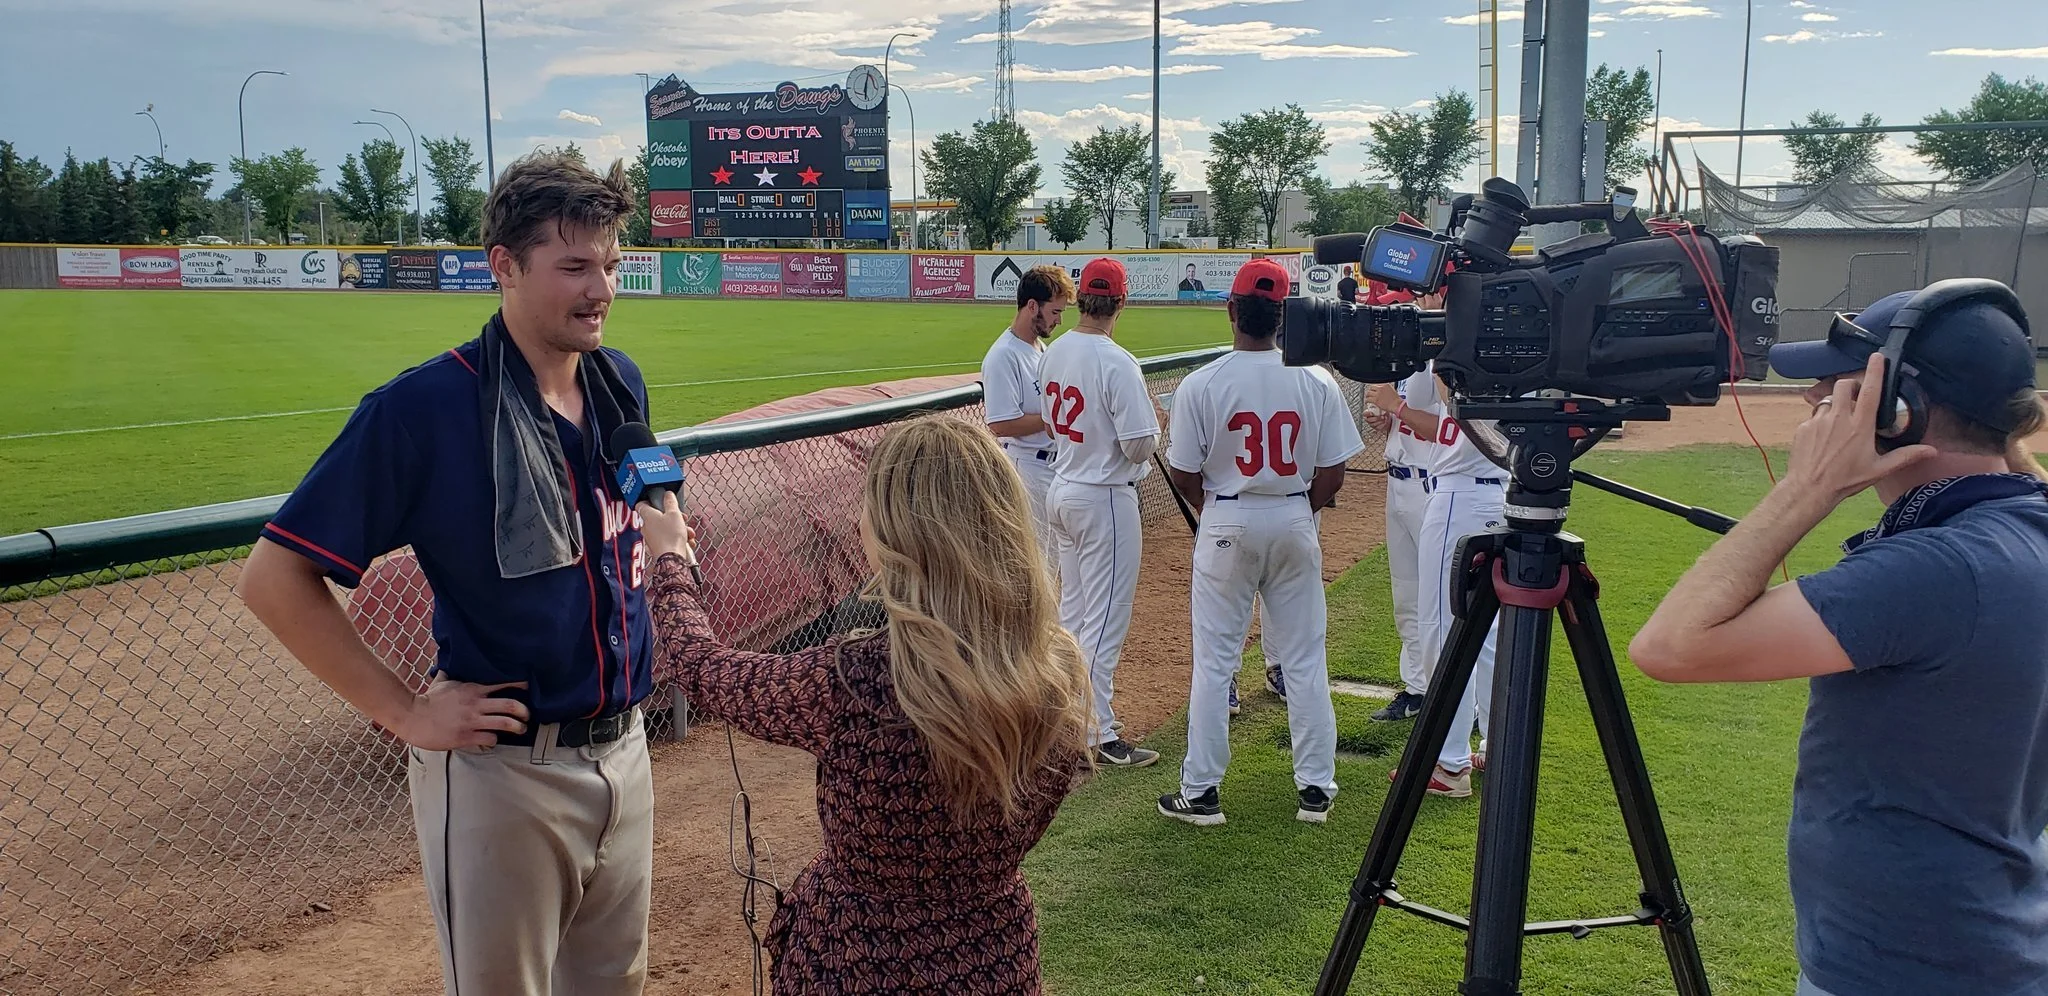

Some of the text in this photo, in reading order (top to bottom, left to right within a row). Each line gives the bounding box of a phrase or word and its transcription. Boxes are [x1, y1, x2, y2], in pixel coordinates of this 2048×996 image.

[650, 89, 687, 109] Seaman
[693, 84, 842, 115] Home of the Dawgs
[651, 100, 692, 119] Stadium
[854, 127, 886, 135] PHOENIX
[650, 141, 688, 153] Okotoks
[651, 154, 688, 169] Sobeys
[848, 158, 881, 167] AM 1140
[719, 195, 737, 204] BALL
[750, 195, 775, 204] STRIKE
[791, 195, 806, 204] OUT
[851, 209, 882, 220] DASANI
[704, 218, 721, 227] EAST
[703, 227, 721, 236] WEST
[180, 252, 196, 262] GOOD
[212, 252, 233, 263] PARTY
[1387, 248, 1410, 260] Global
[129, 260, 173, 268] BOW MARK
[444, 260, 458, 270] NAPA
[814, 256, 831, 264] Best
[862, 258, 903, 267] BUDGET
[1202, 259, 1216, 267] Joel
[1391, 257, 1408, 265] NEWS
[618, 262, 652, 274] OLUMBO'S
[806, 264, 839, 273] Western
[862, 267, 897, 277] BLINDS
[922, 266, 961, 276] AGENCIES
[181, 276, 204, 284] Calgary
[210, 276, 234, 284] Okotoks
[735, 272, 780, 280] Merkley Group
[812, 272, 834, 281] PLUS
[1126, 274, 1169, 285] KOTOKS
[1310, 271, 1330, 280] FORD
[242, 276, 282, 286] 938-4455
[301, 277, 327, 286] CALFRAC
[996, 279, 1019, 287] GIANT
[724, 284, 778, 294] (403) 298-4014
[786, 287, 810, 295] Okotoks
[826, 287, 844, 295] Suites
[914, 281, 972, 297] Insurance Run
[1307, 284, 1331, 294] LINCOLN
[1046, 381, 1085, 443] 22
[1228, 411, 1302, 477] 30
[636, 459, 668, 469] Global
[621, 470, 635, 494] Global
[627, 477, 637, 495] NEWS
